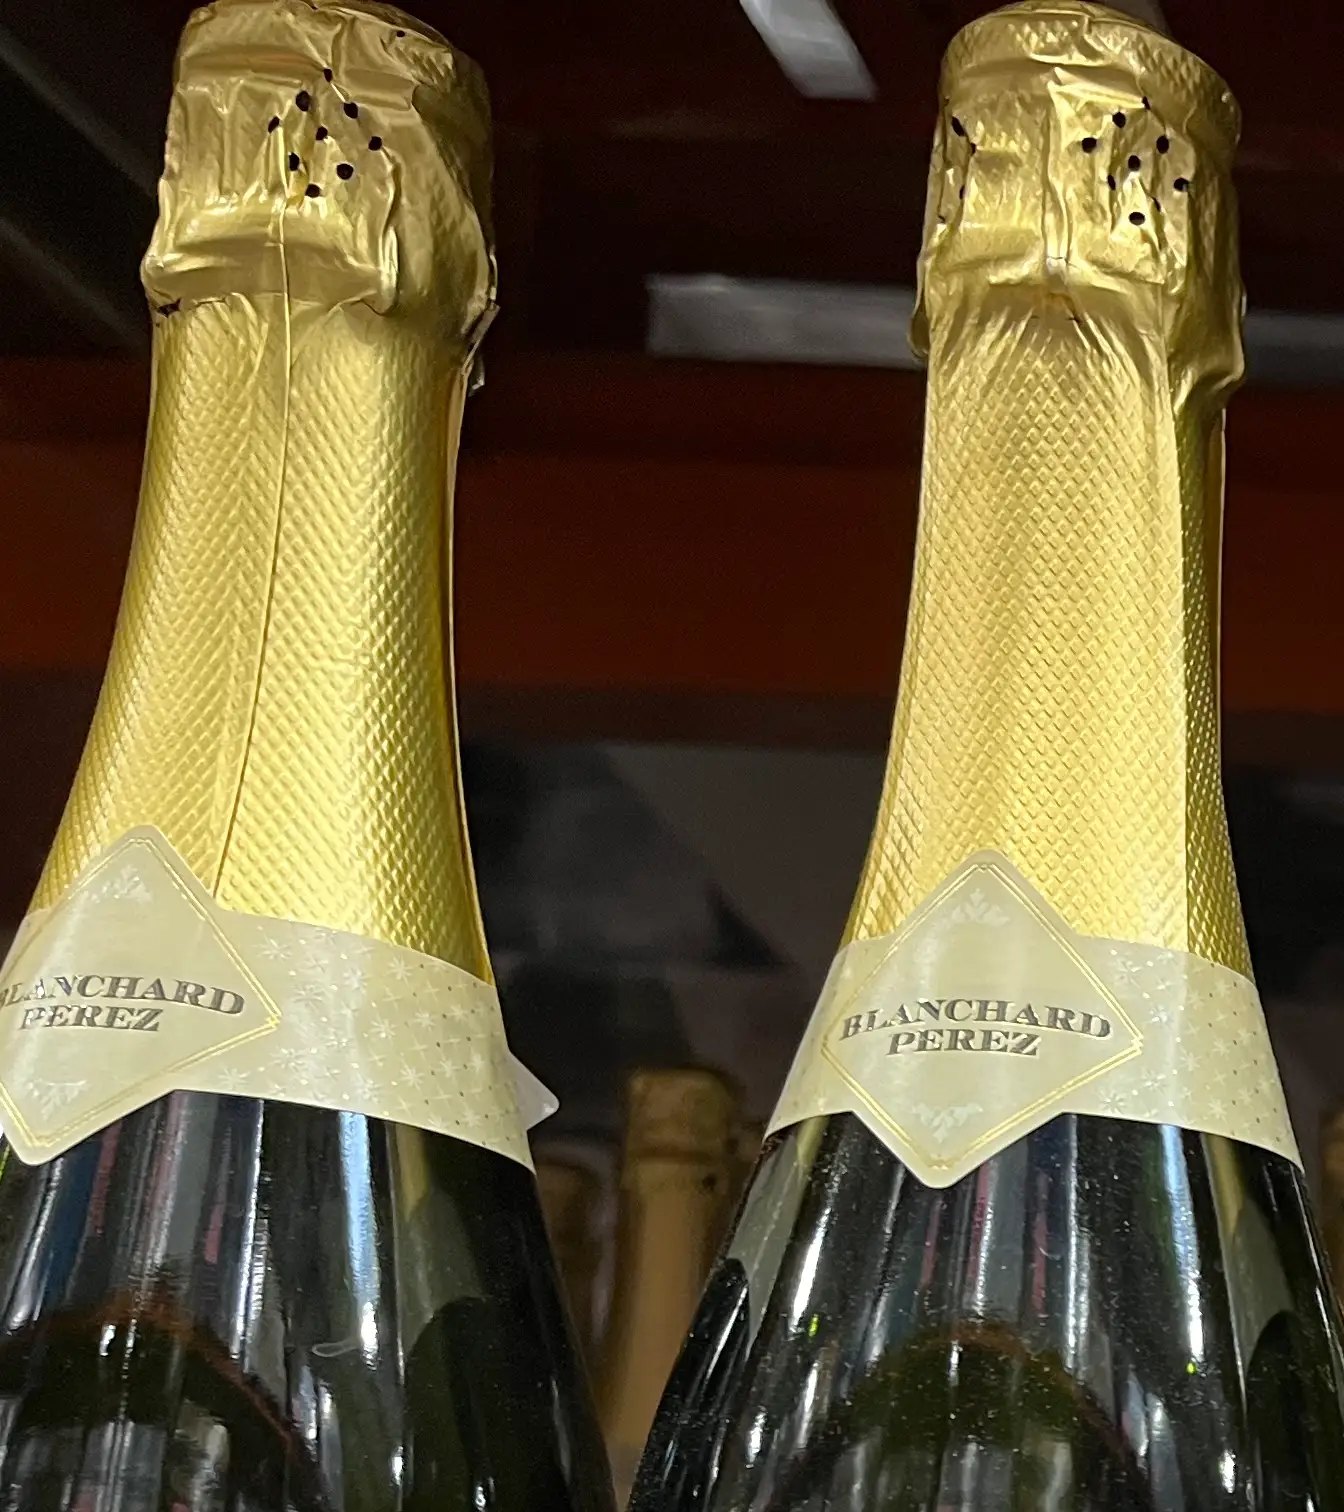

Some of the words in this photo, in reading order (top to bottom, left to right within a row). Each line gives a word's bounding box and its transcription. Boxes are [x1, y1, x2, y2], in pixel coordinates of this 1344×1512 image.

[19, 1004, 163, 1031] PEREZ
[840, 999, 1111, 1039] BLANCHARD
[887, 1028, 1041, 1055] PEREZ
